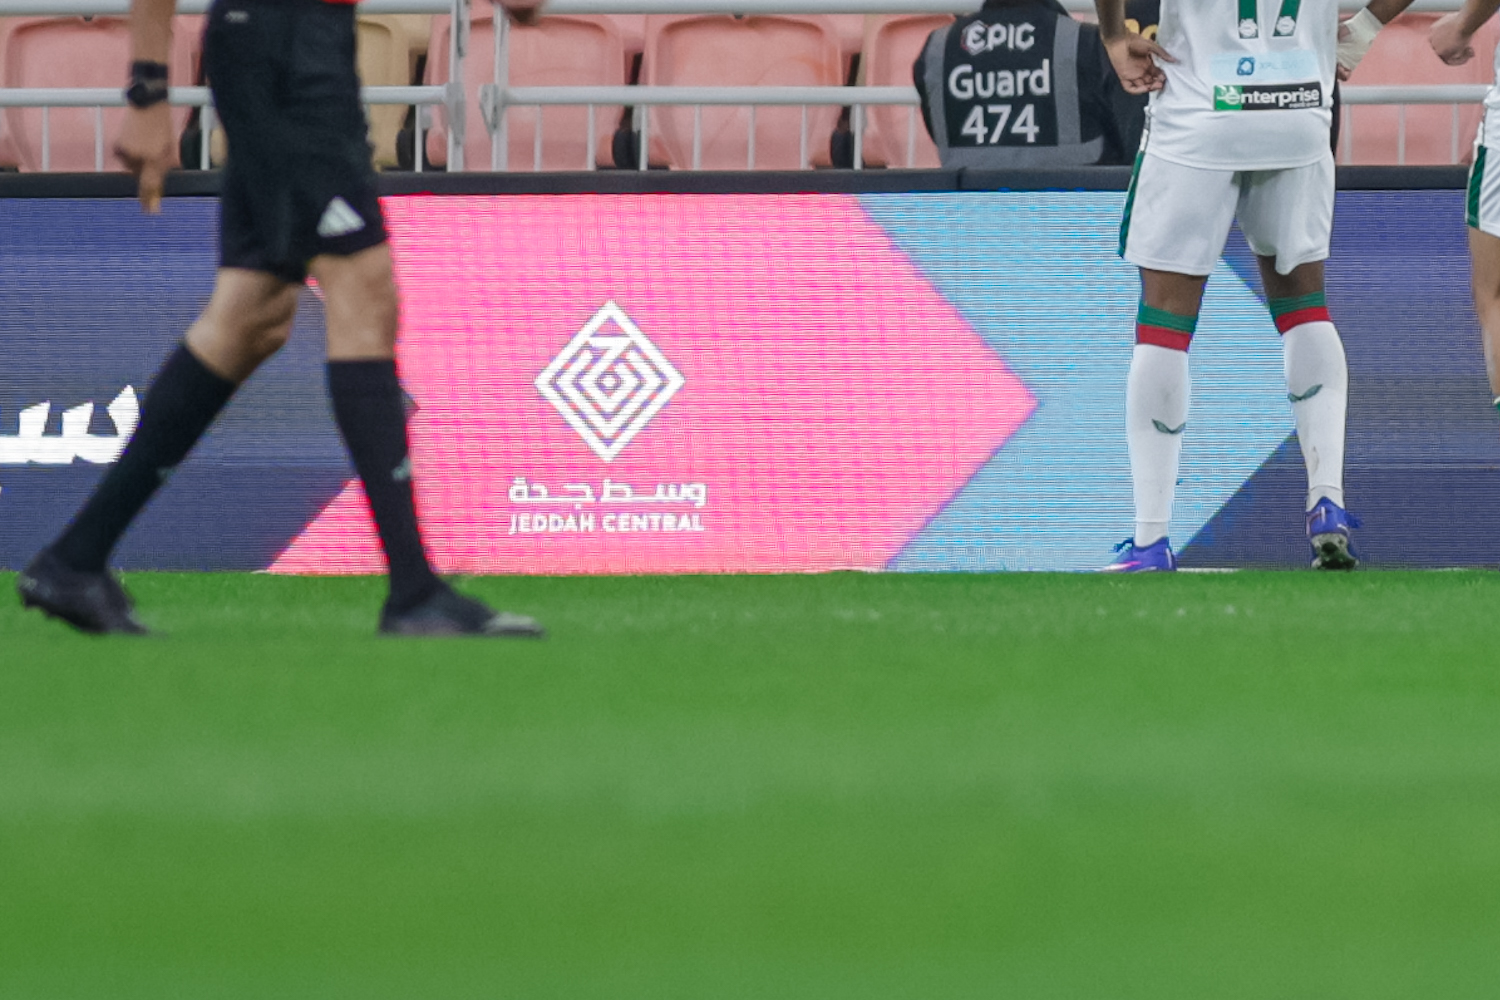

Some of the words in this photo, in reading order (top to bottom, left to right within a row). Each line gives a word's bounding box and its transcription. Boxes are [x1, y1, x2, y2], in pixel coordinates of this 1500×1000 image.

[948, 58, 1050, 99] Guard
[1217, 87, 1320, 107] enterprise
[961, 103, 1040, 144] 474
[508, 476, 598, 510] جدة
[600, 478, 708, 508] وسط
[508, 513, 597, 536] JEDDAH
[602, 513, 706, 533] CENTRAL
